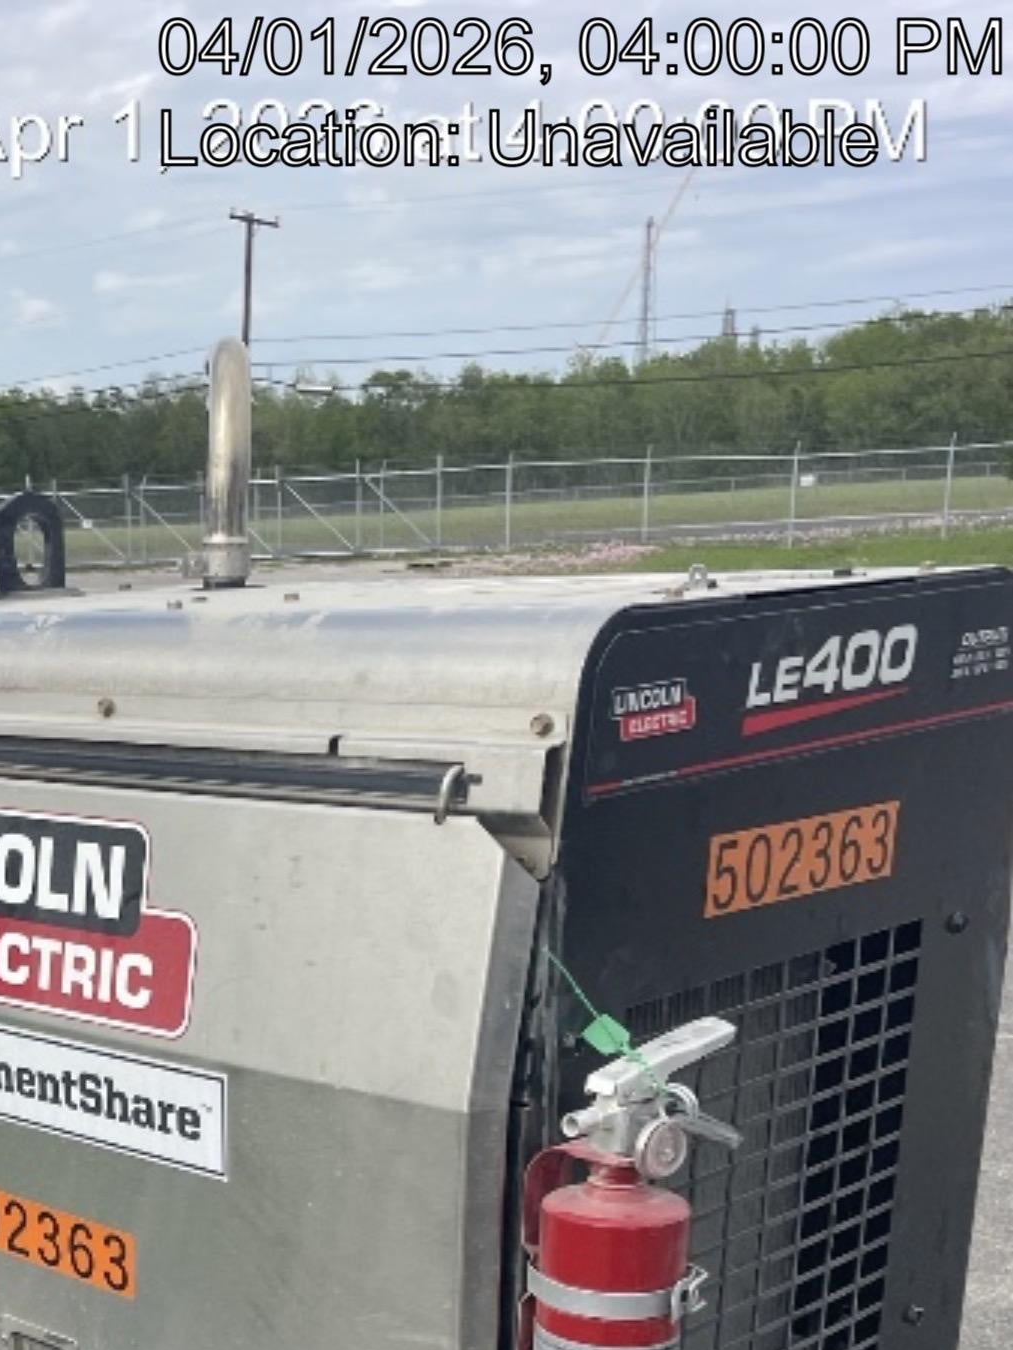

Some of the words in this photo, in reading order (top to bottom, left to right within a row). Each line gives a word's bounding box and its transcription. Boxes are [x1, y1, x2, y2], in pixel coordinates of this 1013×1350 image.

[612, 683, 682, 715] LINCOLN
[745, 624, 918, 709] LE400
[712, 808, 889, 911] 502363
